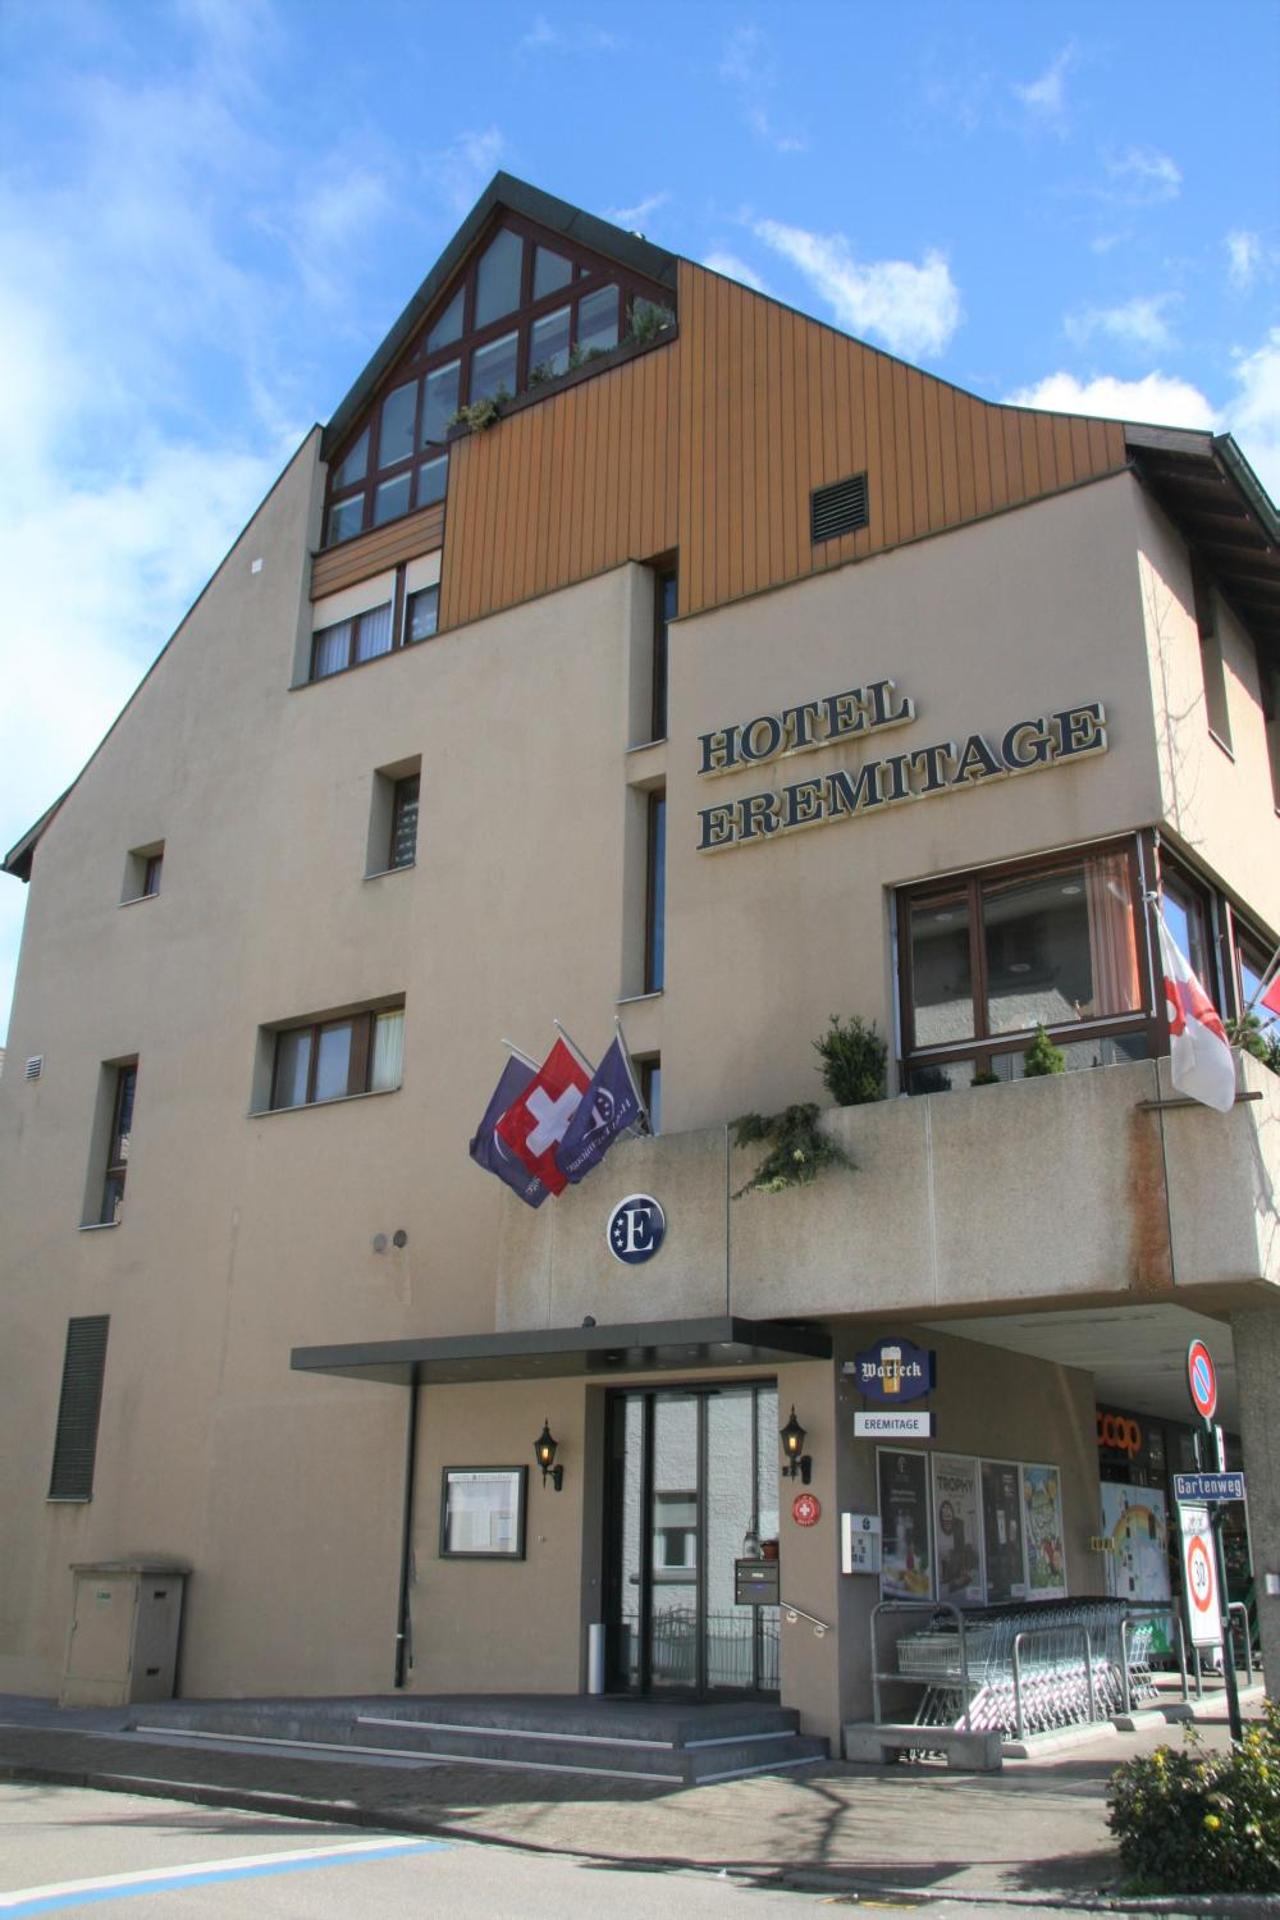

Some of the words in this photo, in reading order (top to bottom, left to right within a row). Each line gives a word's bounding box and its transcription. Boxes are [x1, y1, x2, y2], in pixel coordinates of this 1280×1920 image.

[697, 680, 914, 777] HOTEL
[696, 702, 1106, 853] EREMITAGE
[623, 1208, 654, 1253] E
[864, 1418, 919, 1430] EREMITAGE
[1177, 1475, 1242, 1498] Gartenweg
